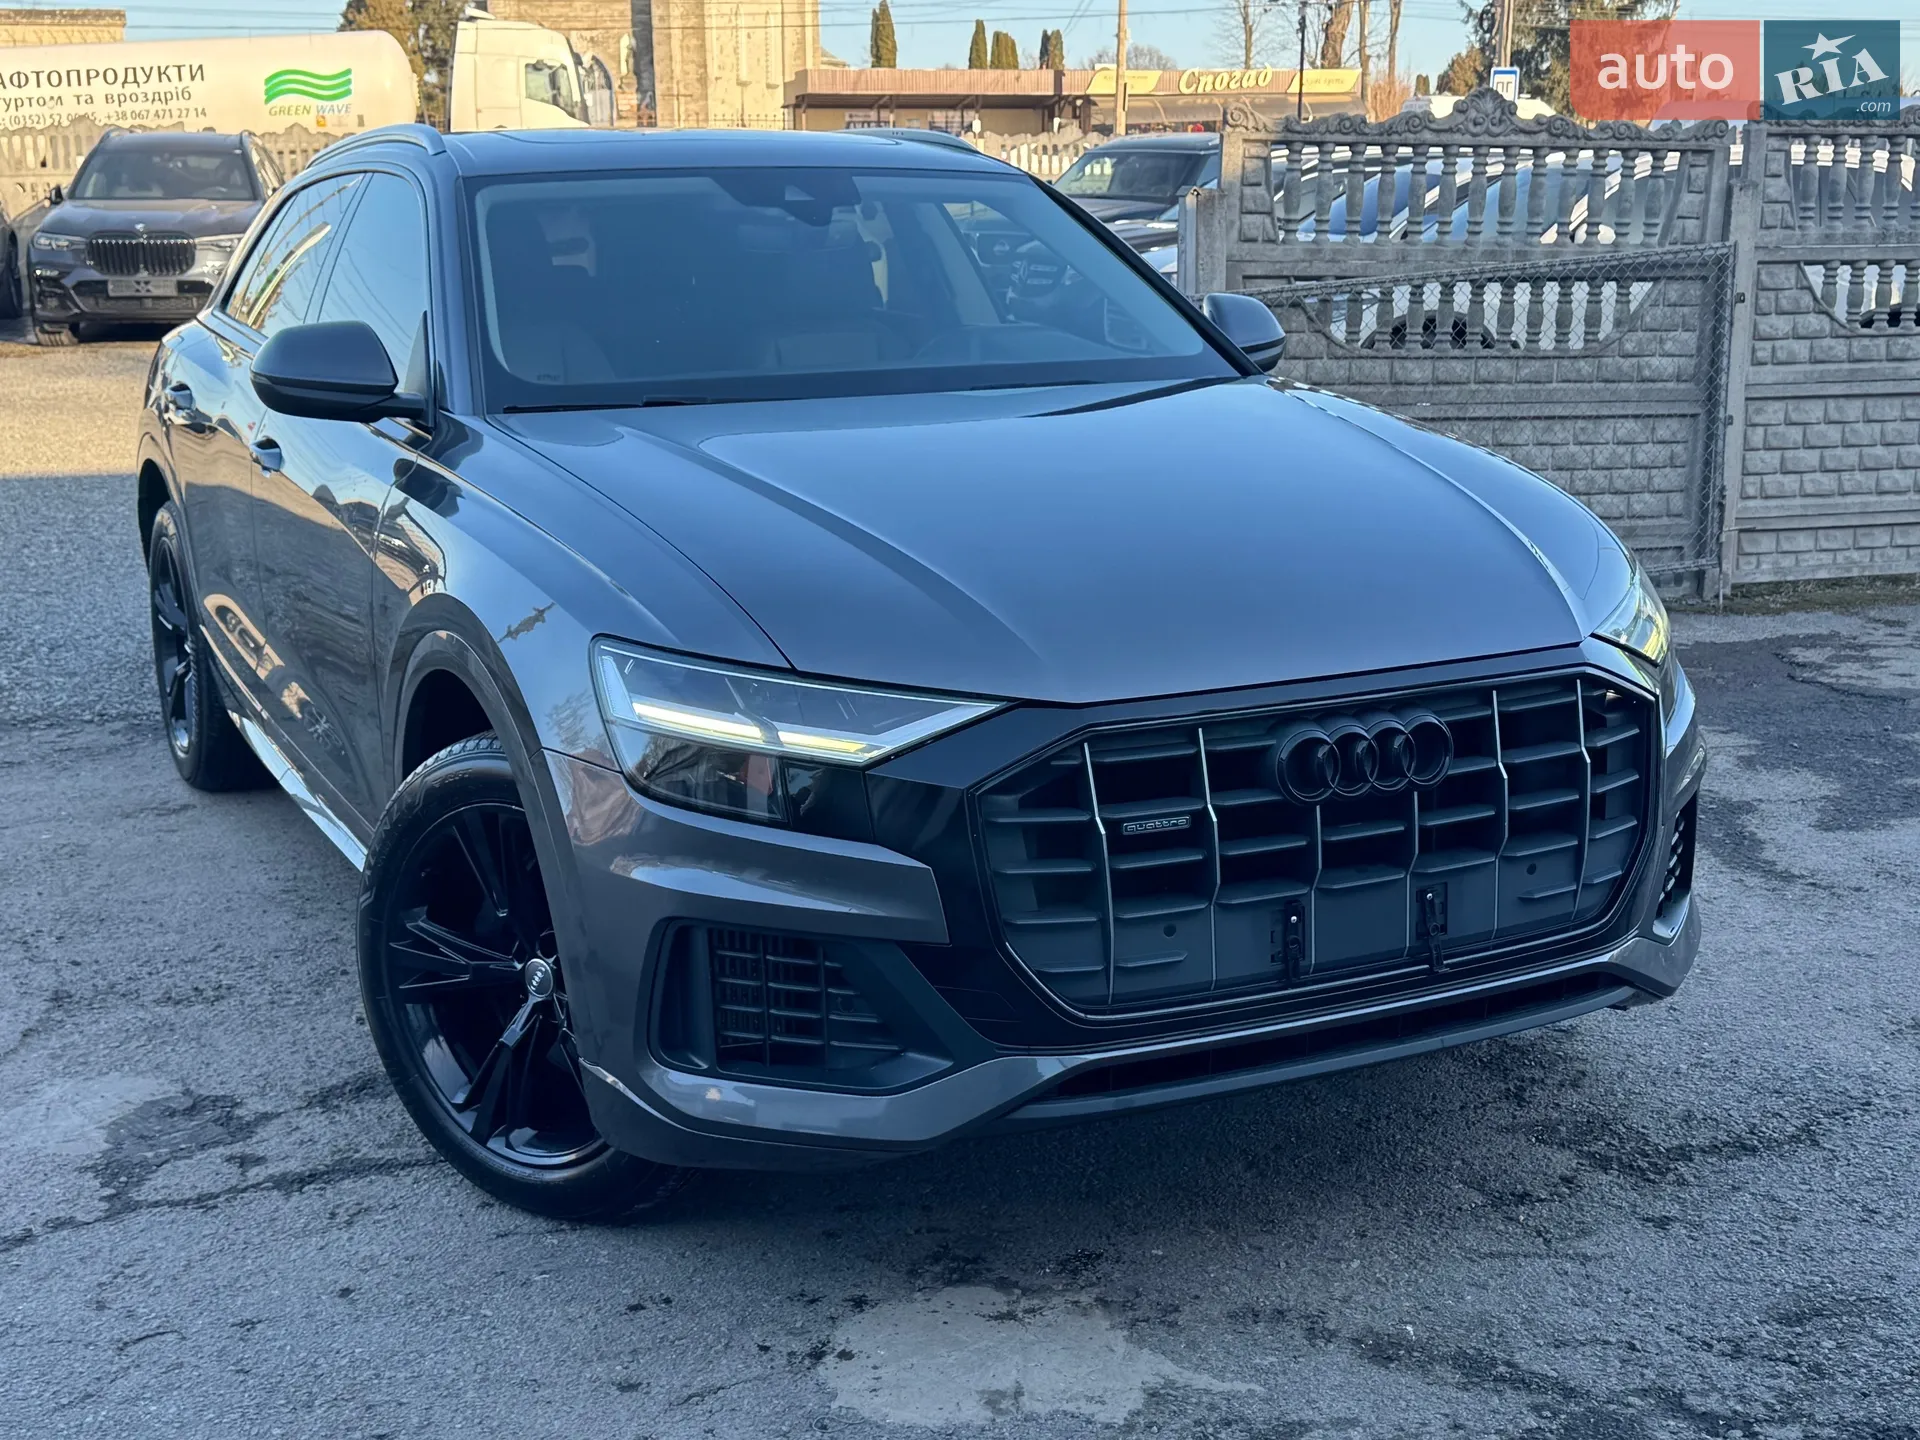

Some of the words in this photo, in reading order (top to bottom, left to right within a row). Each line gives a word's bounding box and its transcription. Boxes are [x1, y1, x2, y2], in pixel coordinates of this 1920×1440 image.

[1179, 62, 1273, 95] Спогад
[0, 95, 64, 112] уртом
[73, 93, 94, 105] та
[105, 86, 192, 107] вроздріб
[9, 113, 46, 126] (0352)
[104, 110, 128, 121] +38
[130, 109, 150, 120] 067
[153, 108, 173, 120] 471
[176, 108, 190, 118] 27
[194, 107, 207, 118] 14
[268, 104, 312, 116] GREEN
[316, 103, 352, 115] WAVE
[1127, 819, 1187, 832] quattro
